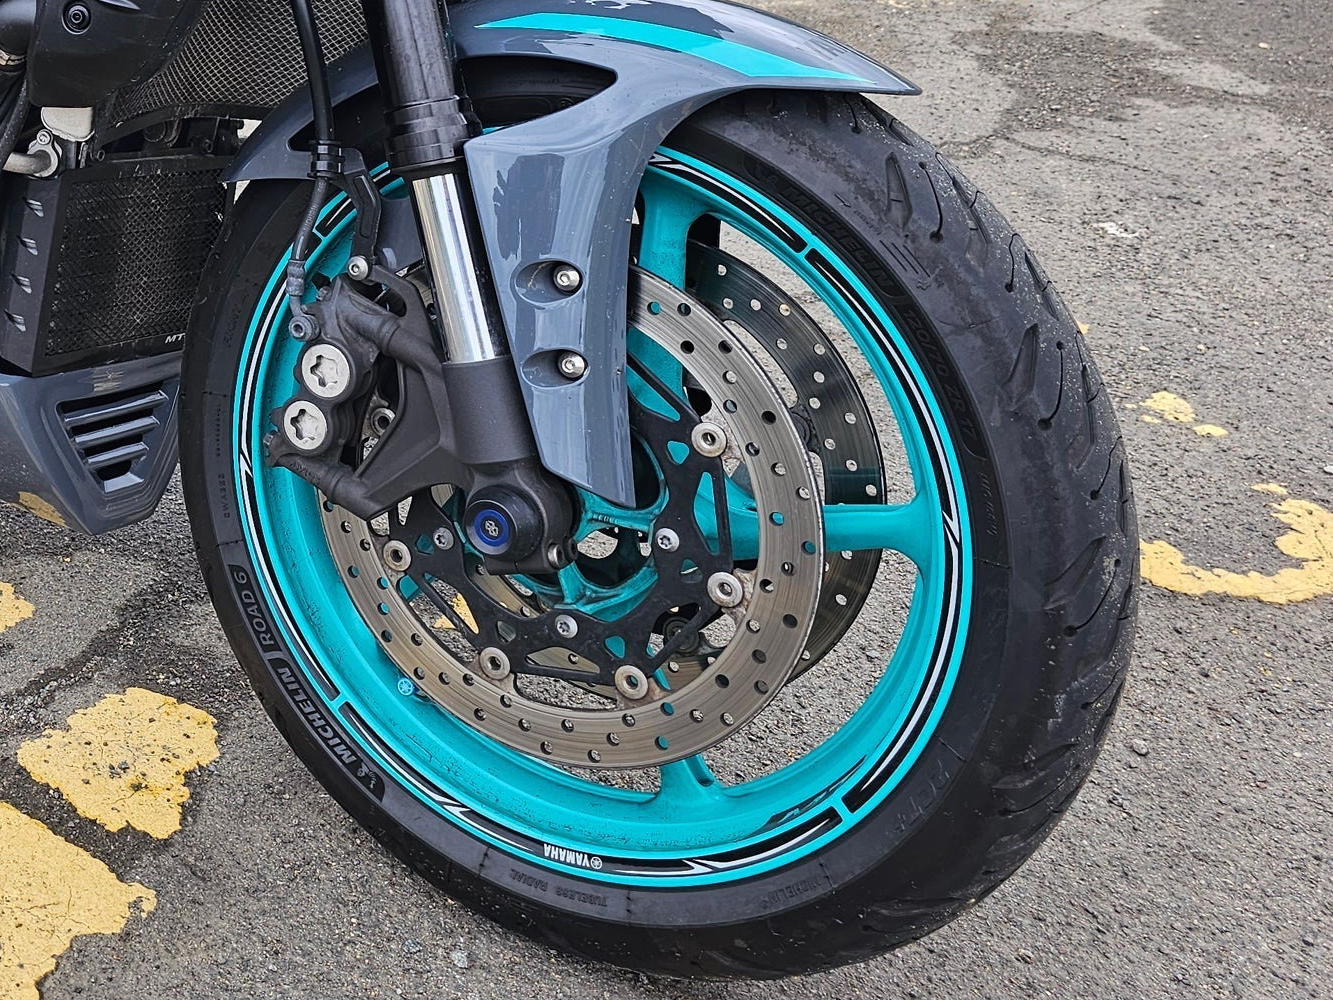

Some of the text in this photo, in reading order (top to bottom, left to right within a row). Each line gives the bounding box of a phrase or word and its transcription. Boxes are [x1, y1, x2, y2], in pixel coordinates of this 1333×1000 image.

[904, 309, 978, 441] 120/70 ZR 17
[233, 570, 357, 765] MICHELIN ROAD 6
[543, 843, 591, 868] YAMAHA
